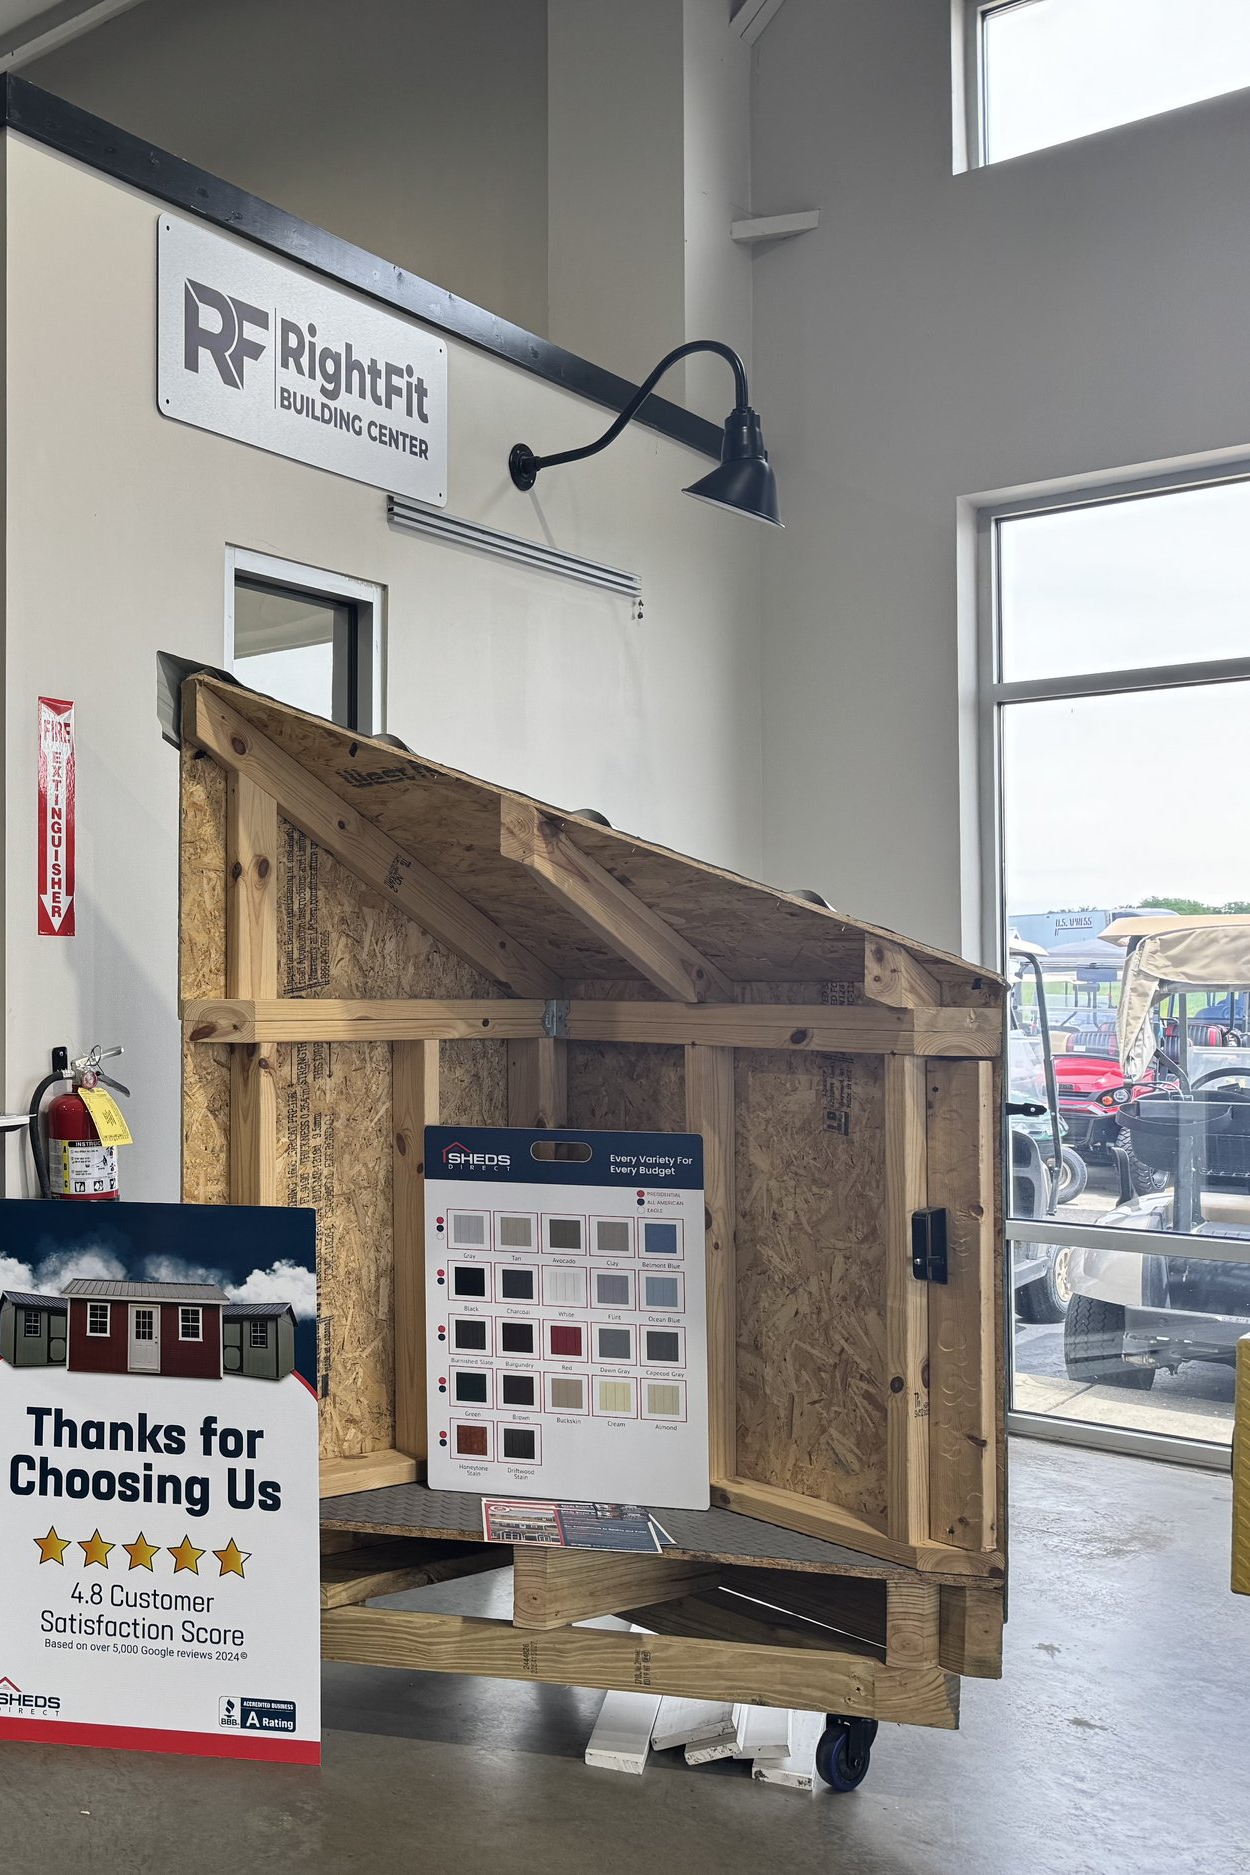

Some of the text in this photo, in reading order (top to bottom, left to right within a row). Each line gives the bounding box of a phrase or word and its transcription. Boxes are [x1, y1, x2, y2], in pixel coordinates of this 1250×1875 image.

[184, 277, 269, 391] RF
[280, 317, 429, 424] RightFit
[280, 386, 429, 460] BUILDING CENTER
[43, 720, 70, 744] FIRE
[51, 751, 62, 918] EXTINGUISHER
[448, 1153, 511, 1166] SHEDS
[610, 1155, 693, 1166] Every Variety For
[610, 1165, 676, 1177] Every Budget
[463, 1252, 476, 1261] Gray
[552, 1257, 576, 1265] Avocado
[606, 1260, 619, 1268] Clay
[27, 1406, 264, 1459] Thanks for
[507, 1467, 535, 1475] Driftwood
[10, 1454, 281, 1517] Choosing Us
[71, 1582, 214, 1613] 4.8 Customer
[40, 1610, 244, 1647] Satisfaction Score
[45, 1638, 74, 1651] Based
[76, 1642, 88, 1651] on
[90, 1643, 110, 1653] over
[113, 1643, 139, 1655] 5,000
[141, 1645, 175, 1658] Google
[177, 1649, 213, 1660] reviews
[246, 1711, 294, 1730] A Rating
